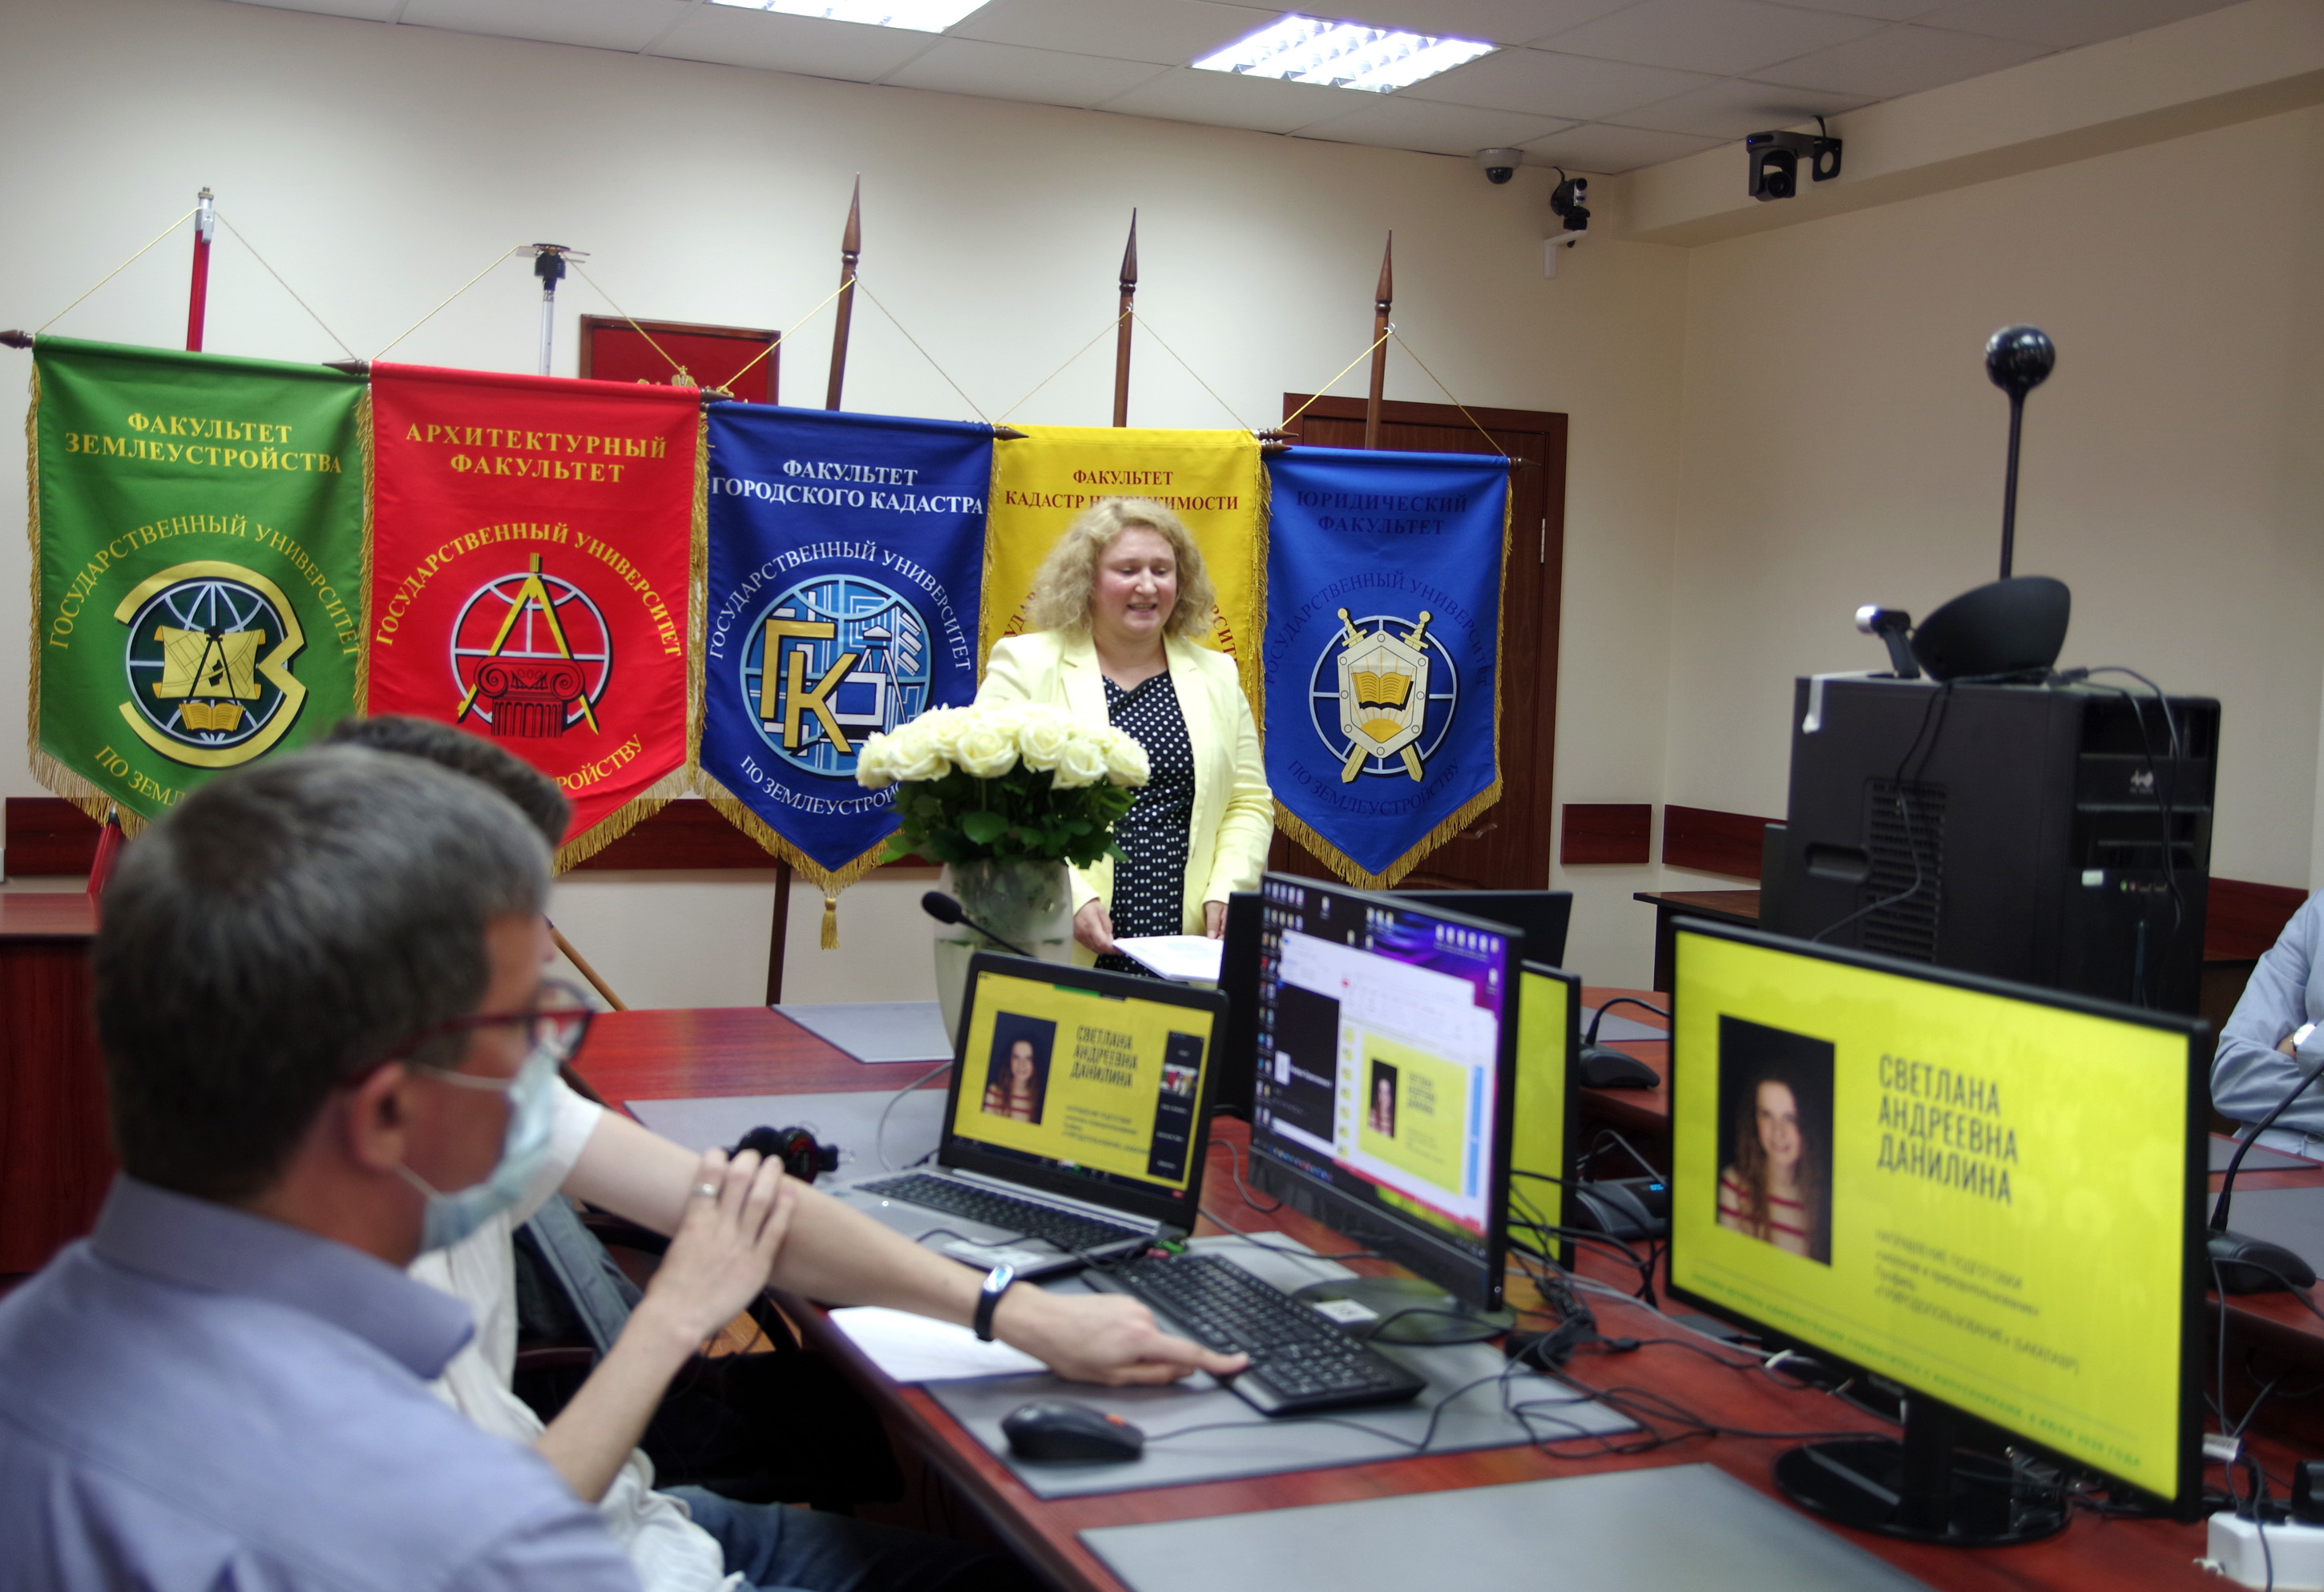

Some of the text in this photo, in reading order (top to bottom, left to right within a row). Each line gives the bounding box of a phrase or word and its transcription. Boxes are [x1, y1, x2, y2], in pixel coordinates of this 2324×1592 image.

[128, 413, 292, 444] ФАКУЛЬТЕТ
[406, 423, 667, 459] АРХИТЕКТУРНЫЙ
[65, 433, 342, 474] ЗЕМЛЕУСТРОЙСТВА
[450, 454, 625, 483] ФАКУЛЬТЕТ
[782, 460, 918, 486] ФАКУЛЬТЕТ
[1073, 470, 1173, 486] ФАКУЛЬТЕТ
[711, 477, 983, 515] ГОРОДСКОГО КАДАСТРА
[1005, 490, 1084, 510] КАДАСТР
[1297, 490, 1467, 514] ЮРИДИЧЕСКИЙ
[1318, 517, 1444, 535] ФАКУЛЬТЕТ
[49, 514, 361, 655] ГОСУДАРСТВЕННЫЙ УНИВЕРСИТЕТ
[377, 522, 682, 657] ГОСУДАРСТВЕННЫЙ УНИВЕРСИТЕТ
[709, 539, 972, 671] ГОСУДАРСТВЕННЫЙ УНИВЕРСИТЕТ
[1265, 570, 1405, 685] ГОСУДАРСТВЕННЫЙ
[1410, 578, 1488, 687] УНИВЕРСИТЕТ
[95, 745, 128, 777] ПО
[740, 755, 764, 784] ПО
[1289, 758, 1461, 816] ПО ЗЕМЛЕУСТРОЙСТВУ
[1076, 1025, 1133, 1050] СВЕТЛАНА
[1074, 1044, 1138, 1070] АНДРЕЕВНА
[1071, 1061, 1133, 1088] ДАНИЛИНА
[1879, 1053, 2001, 1118] СВЕТЛАНА
[1878, 1094, 2019, 1165] АНДРЕЕВНА
[1876, 1132, 2012, 1207] ДАНИЛИНА
